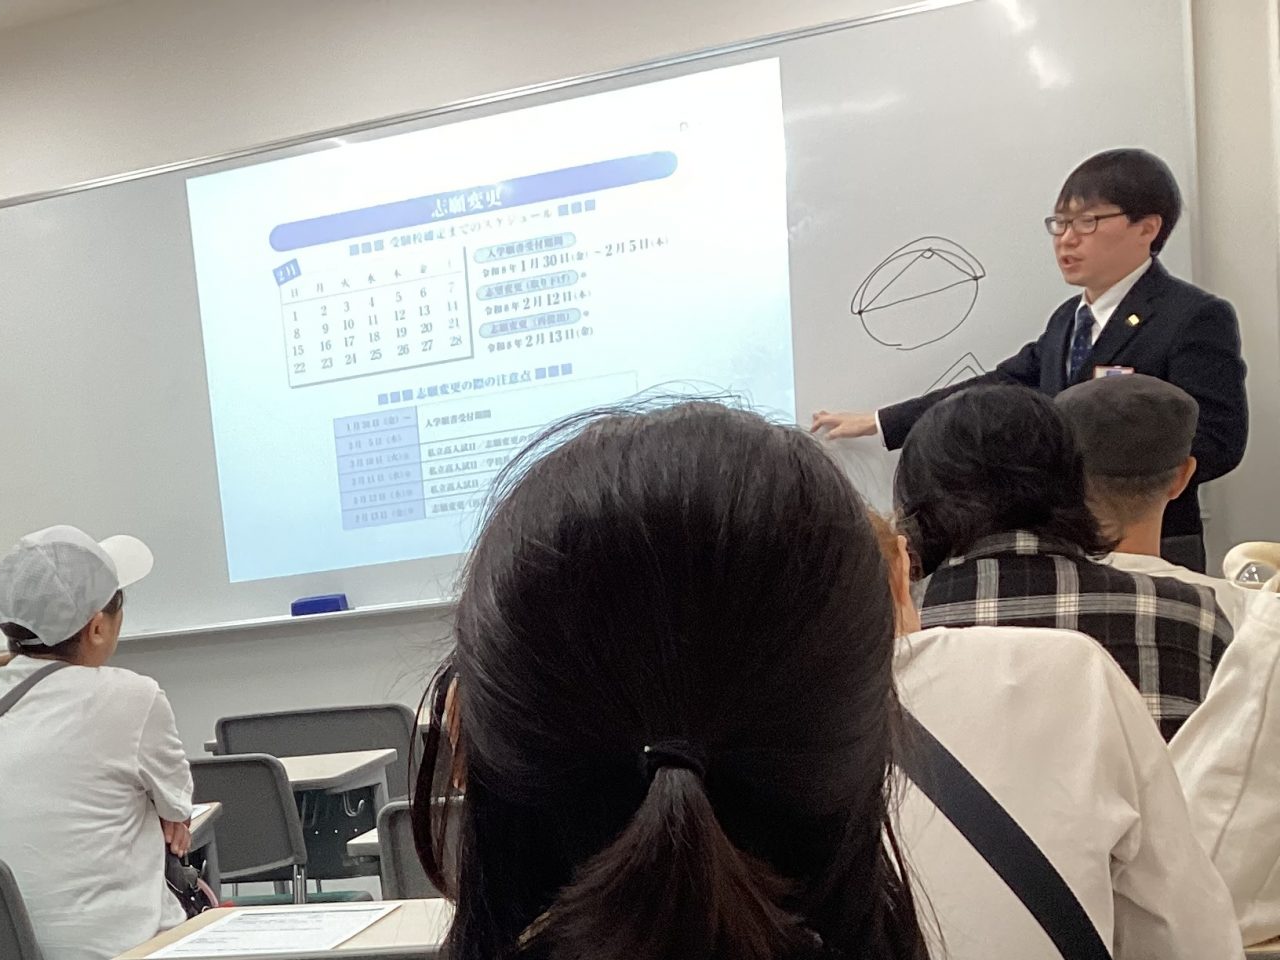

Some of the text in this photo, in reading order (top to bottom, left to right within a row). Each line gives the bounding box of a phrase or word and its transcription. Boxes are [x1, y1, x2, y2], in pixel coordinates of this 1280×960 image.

[293, 317, 459, 356] 15 16 17 18 19 20 21
[343, 319, 355, 331] 10
[368, 314, 378, 326] 11
[394, 309, 406, 321] 12
[418, 305, 430, 317] 13
[294, 335, 462, 374] 22 23 24 25 26 27 28
